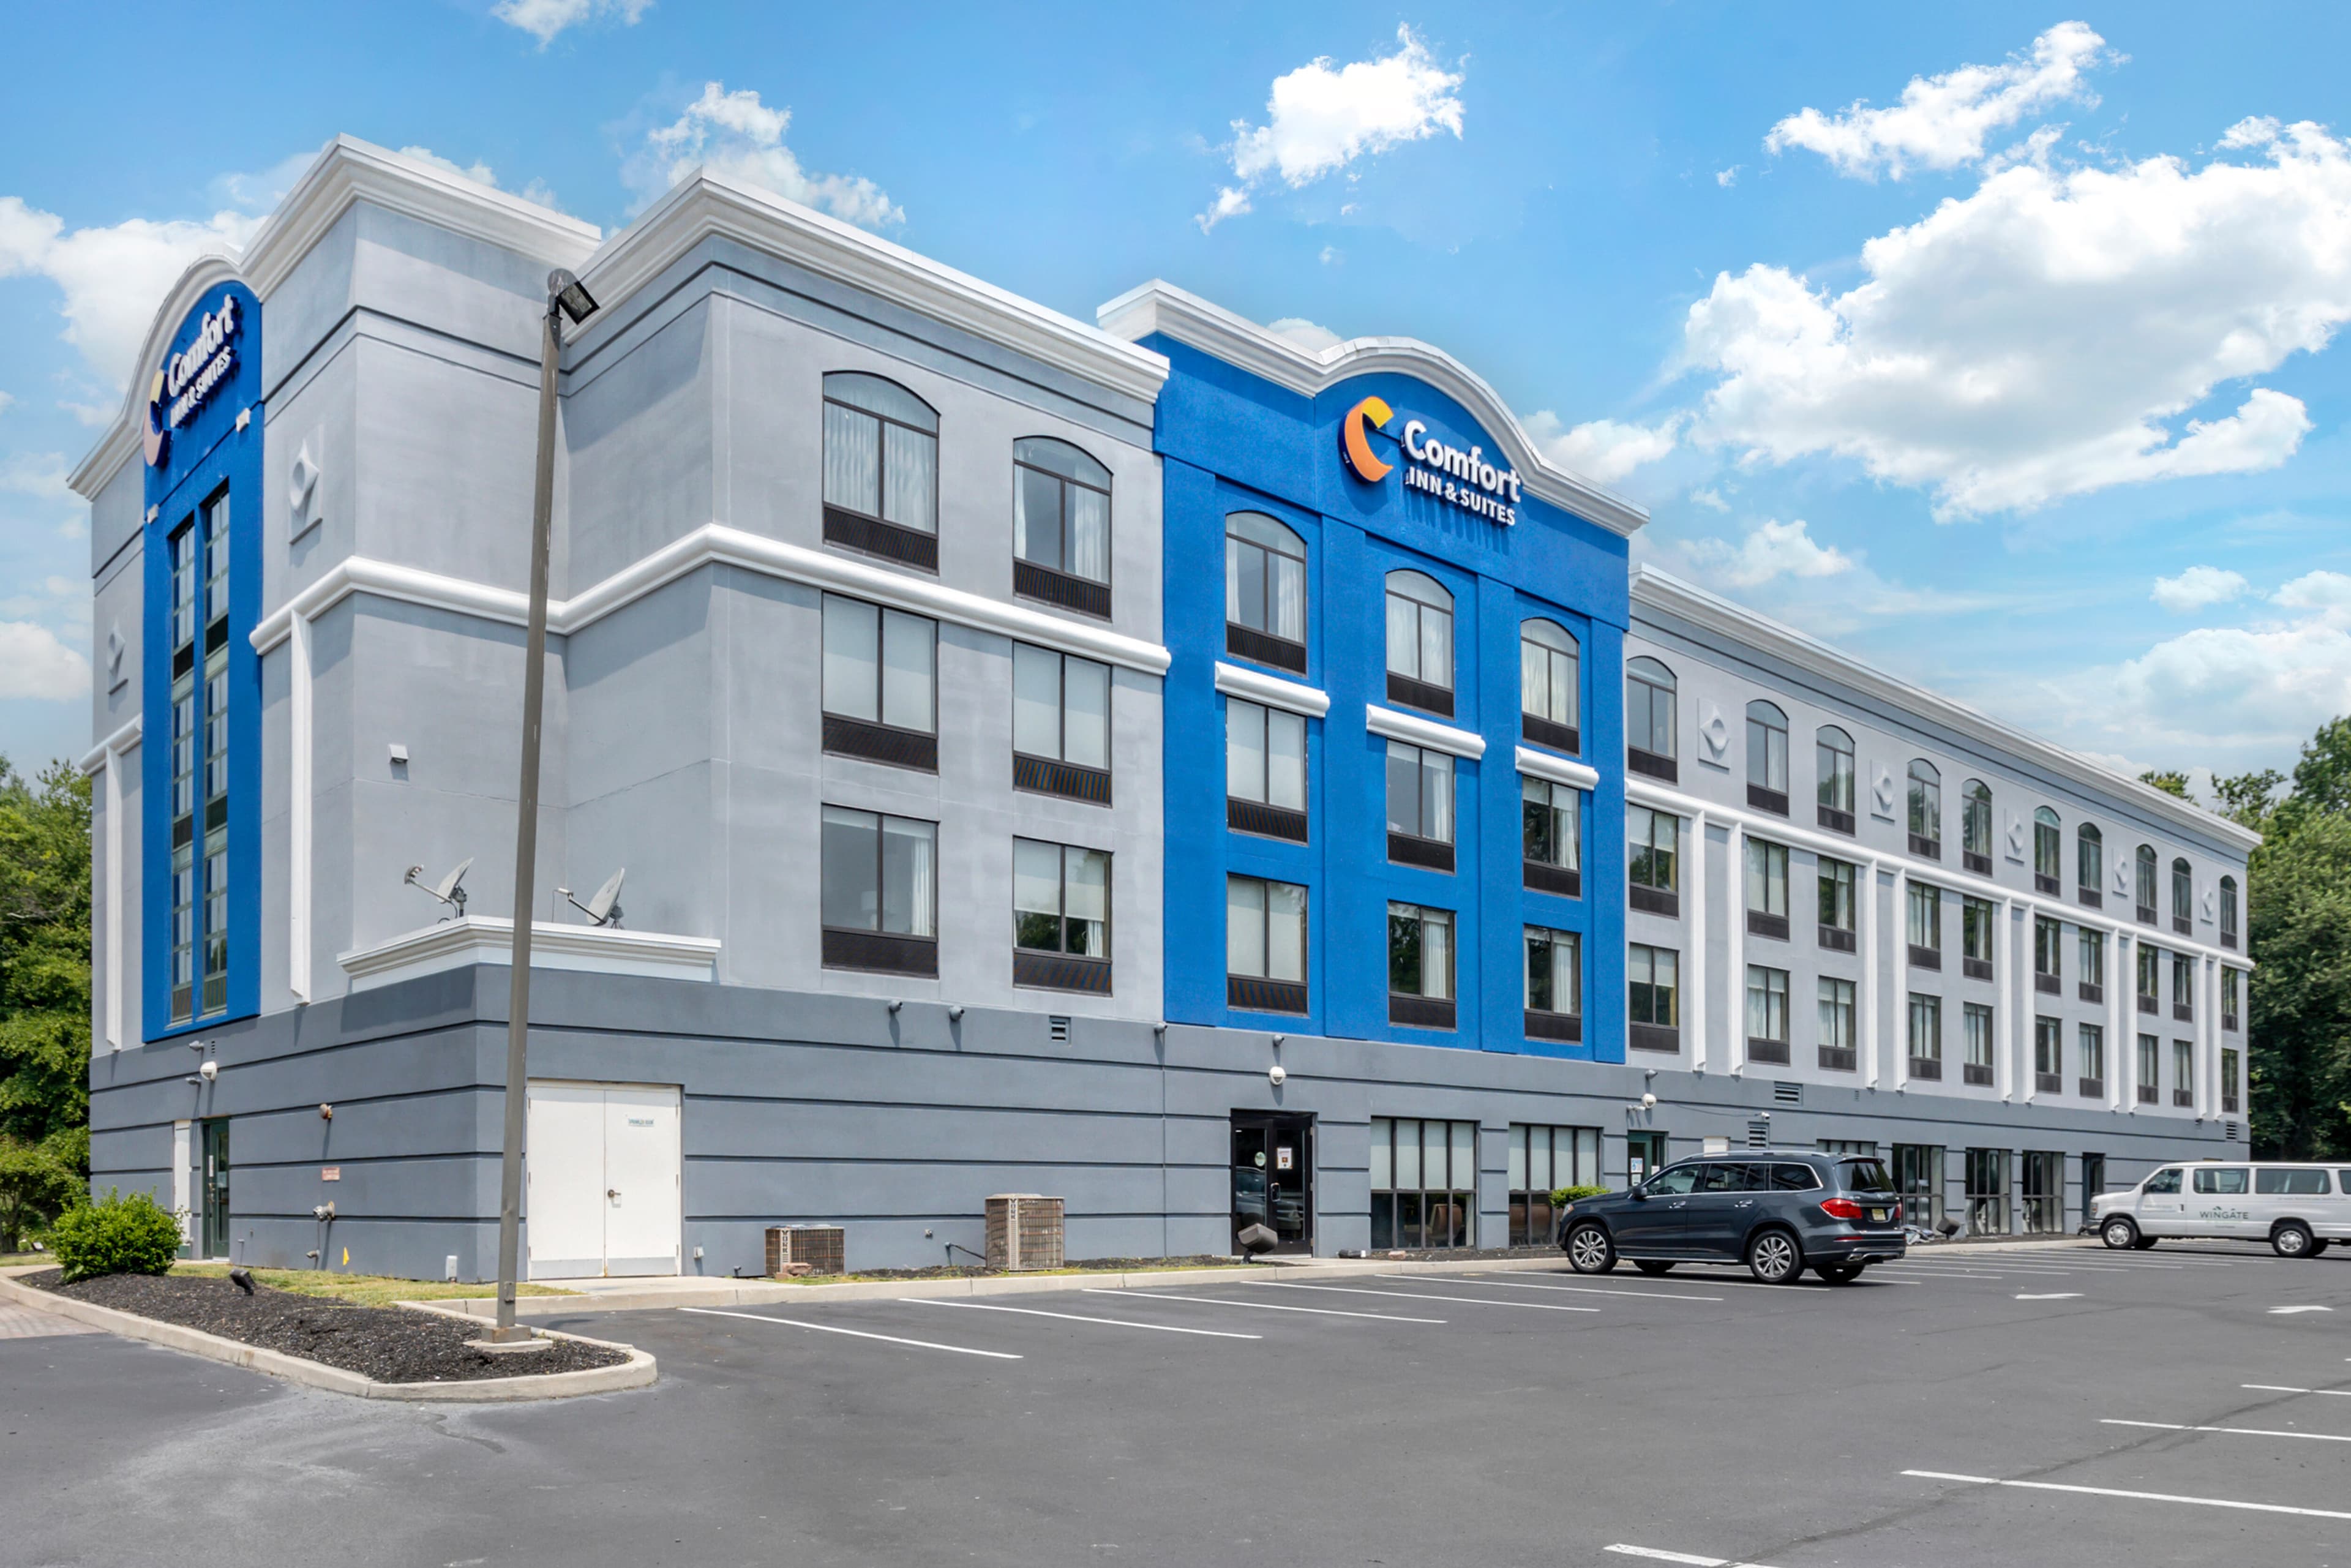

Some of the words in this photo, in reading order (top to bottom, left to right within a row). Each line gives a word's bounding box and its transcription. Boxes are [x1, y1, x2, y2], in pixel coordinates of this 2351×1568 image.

[168, 293, 234, 397] Comfort
[1404, 419, 1521, 503] Comfort
[1409, 467, 1442, 496] INN
[1445, 482, 1458, 503] &
[1460, 488, 1516, 527] SUITES
[2199, 1211, 2249, 1220] WINGATE
